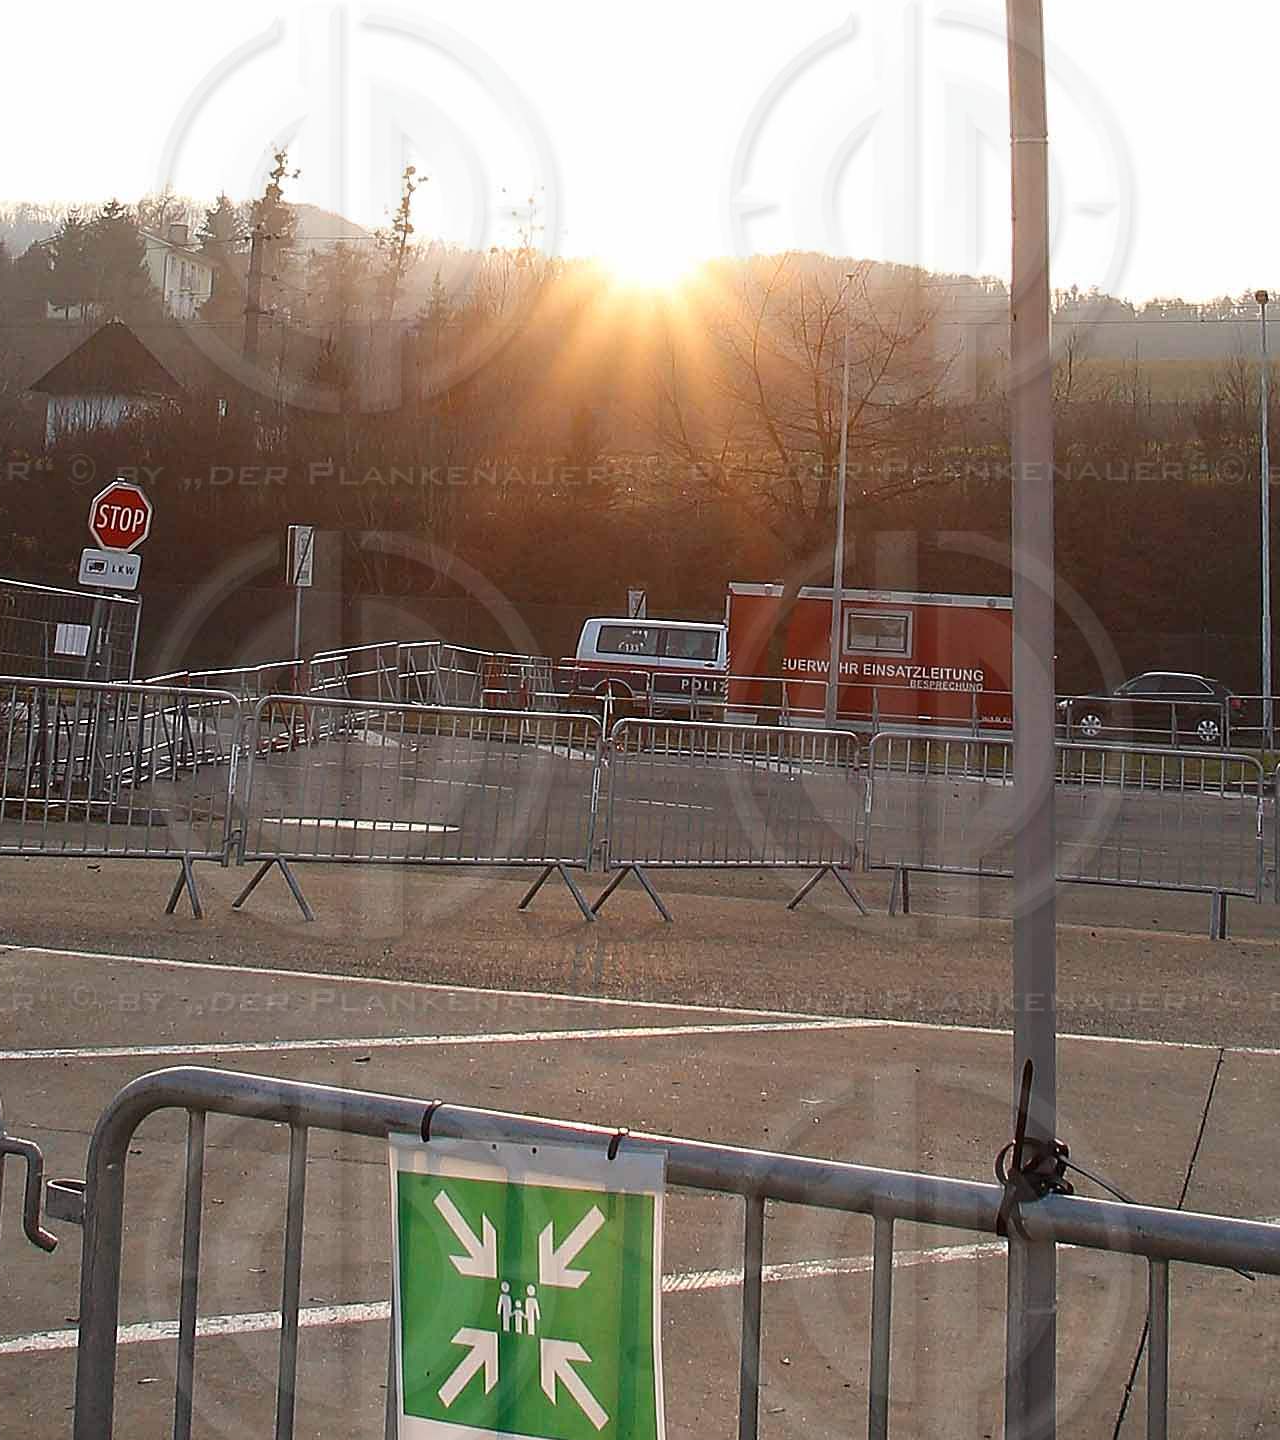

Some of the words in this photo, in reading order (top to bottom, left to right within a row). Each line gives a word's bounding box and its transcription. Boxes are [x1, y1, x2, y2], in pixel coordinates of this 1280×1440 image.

[96, 504, 145, 533] STOP
[111, 563, 136, 577] LKW
[783, 658, 858, 675] EUERWHR
[863, 663, 984, 682] EINSATZLEITUNG
[681, 678, 726, 692] POLIZ
[910, 680, 984, 692] BESPRECHUNG
